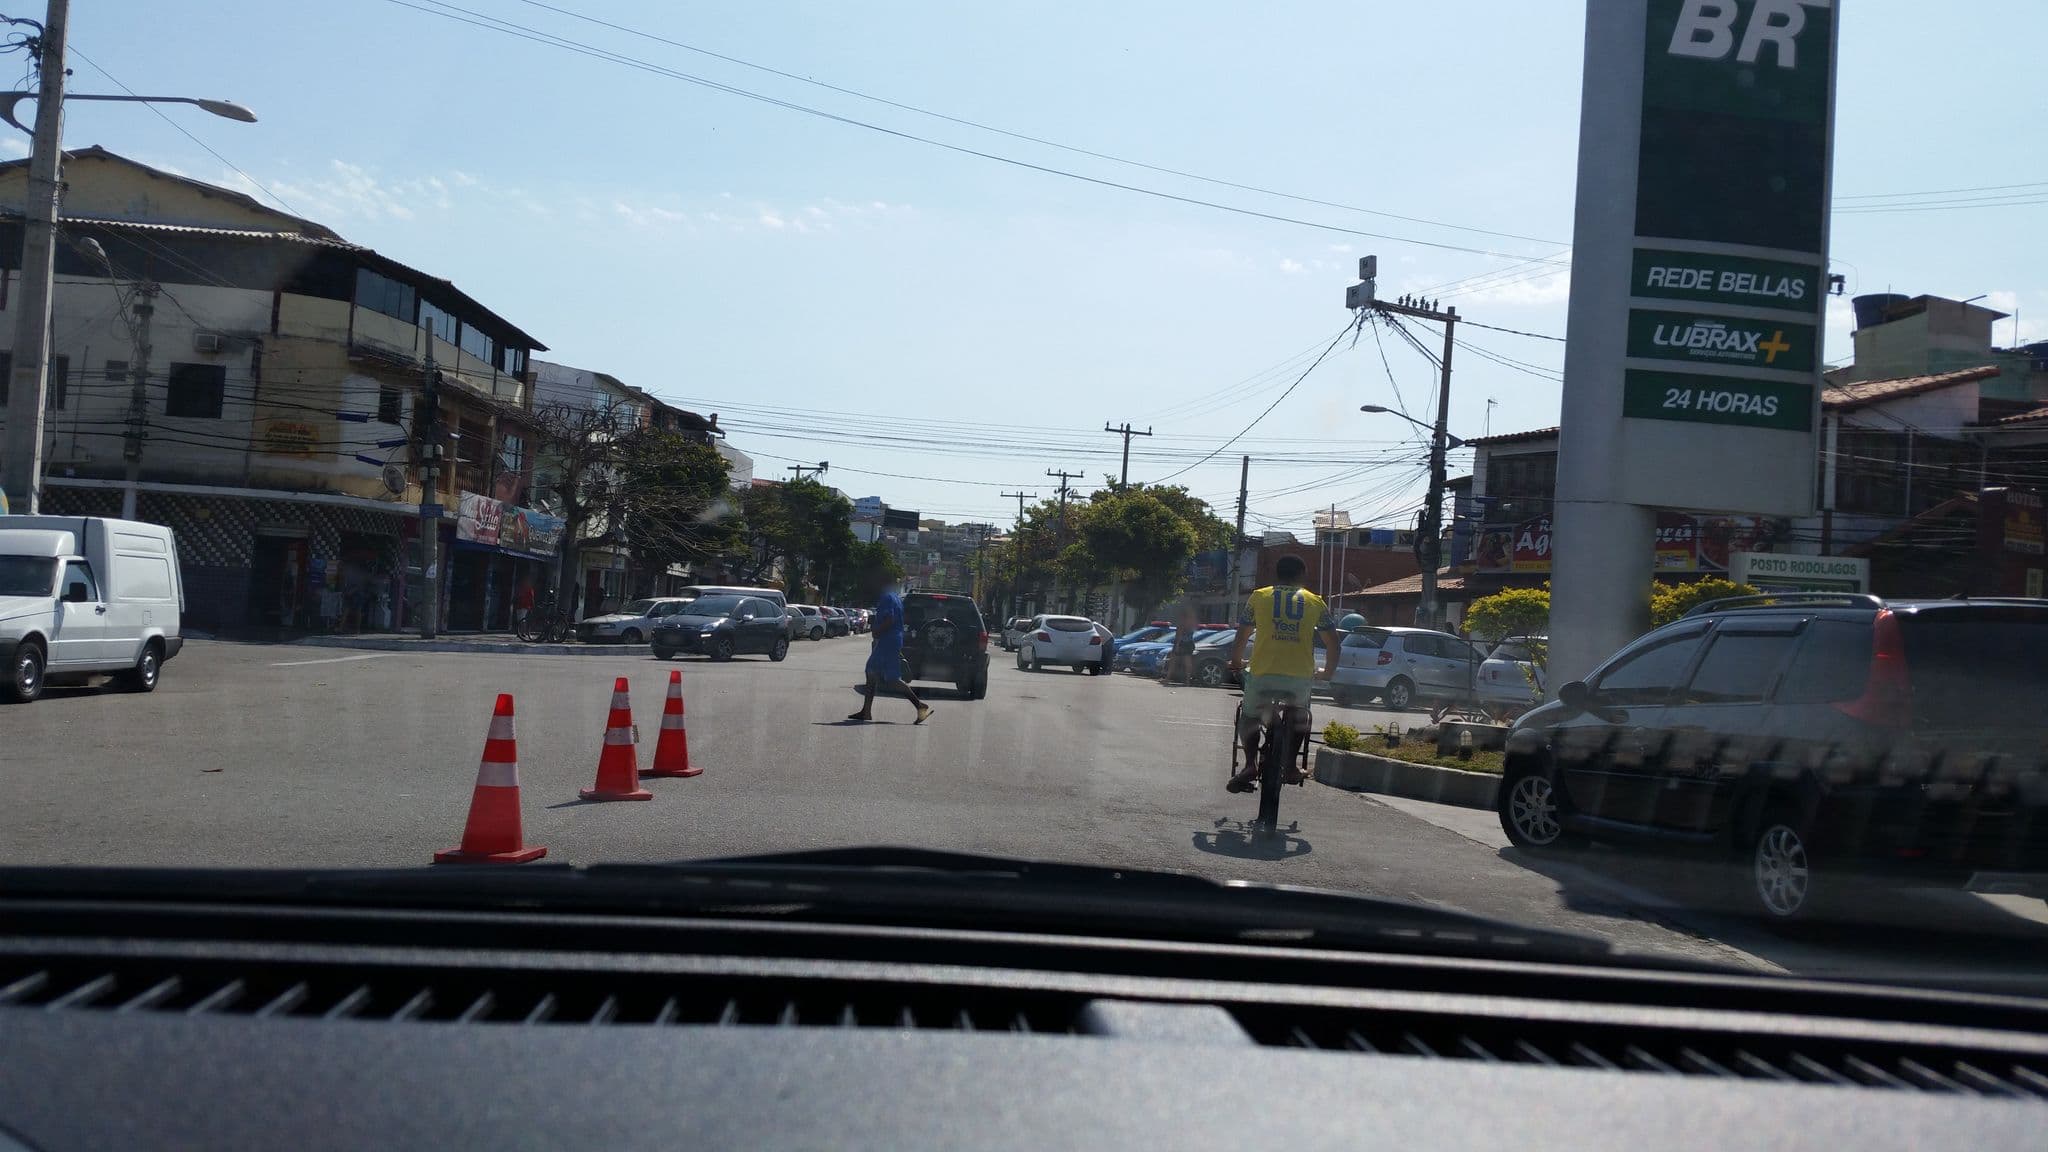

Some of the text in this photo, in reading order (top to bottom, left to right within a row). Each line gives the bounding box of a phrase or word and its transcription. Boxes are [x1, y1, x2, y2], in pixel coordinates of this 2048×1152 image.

[1668, 0, 1806, 70] BR
[1646, 266, 1806, 299] REDE BELLAS
[1663, 388, 1778, 417] 24 HORAS
[1750, 558, 1857, 575] POSTO RODOLAGOS
[1272, 589, 1305, 620] 10
